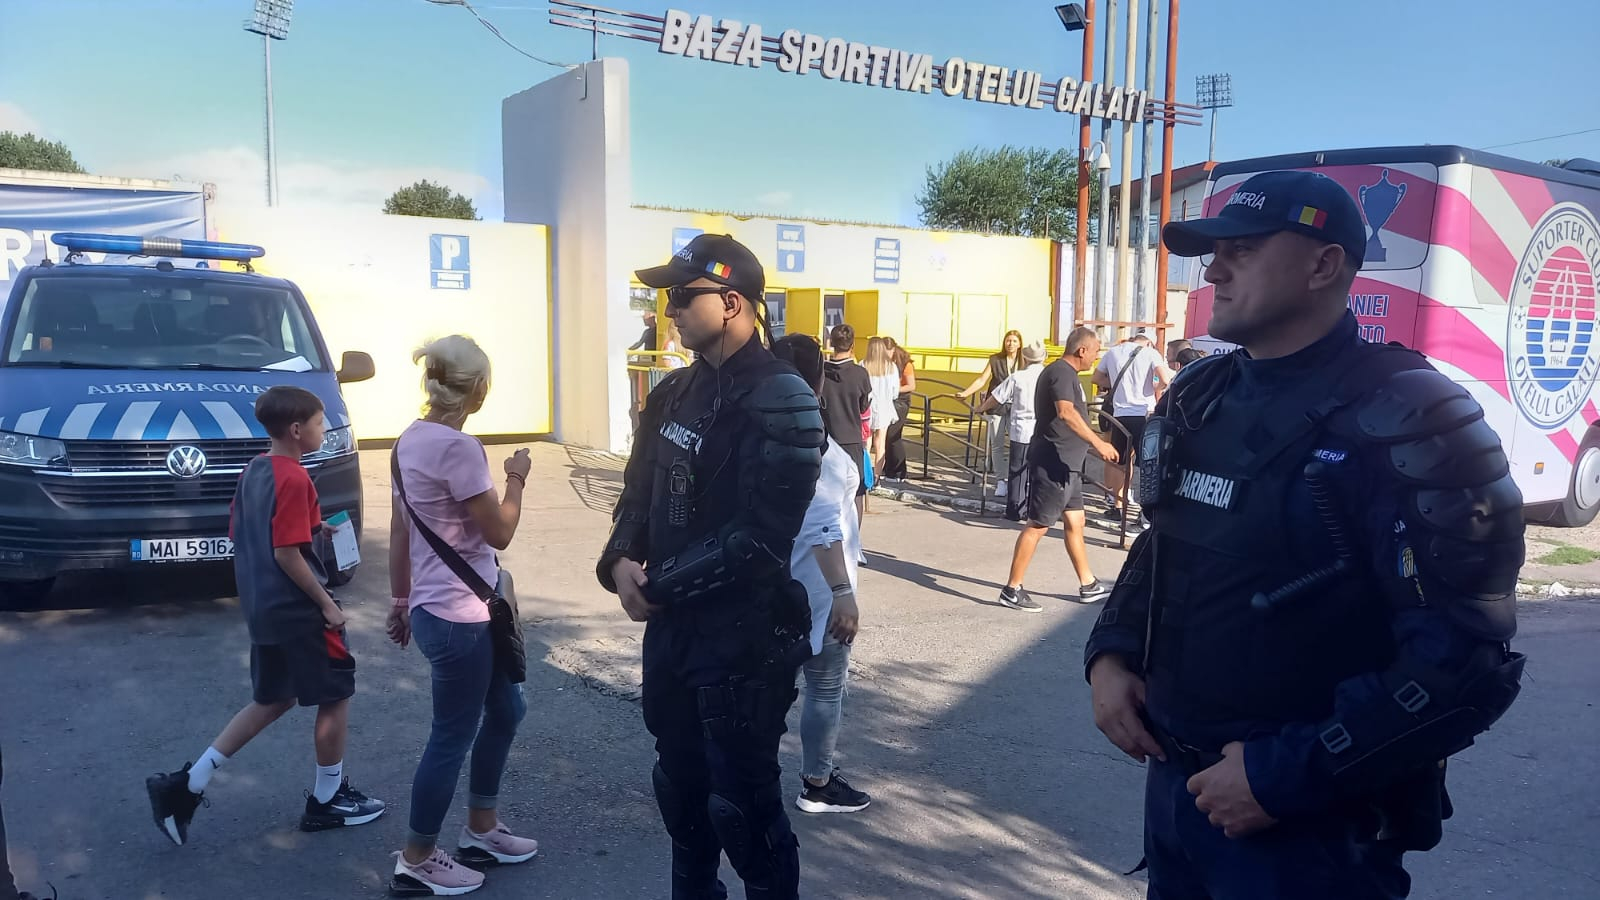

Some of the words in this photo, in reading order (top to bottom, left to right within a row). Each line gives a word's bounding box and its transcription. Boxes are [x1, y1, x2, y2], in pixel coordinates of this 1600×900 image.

[659, 8, 763, 68] BAZA
[775, 28, 932, 94] SPORTIVA
[941, 56, 1044, 109] OTELUL
[1053, 75, 1148, 123] GALATI
[441, 237, 461, 270] P
[1523, 220, 1585, 289] SUPORTER
[1585, 237, 1600, 294] CLU
[1550, 355, 1564, 366] 1964
[1514, 356, 1550, 417] OTELUL
[1554, 355, 1596, 415] GALATI
[149, 541, 179, 558] MAI
